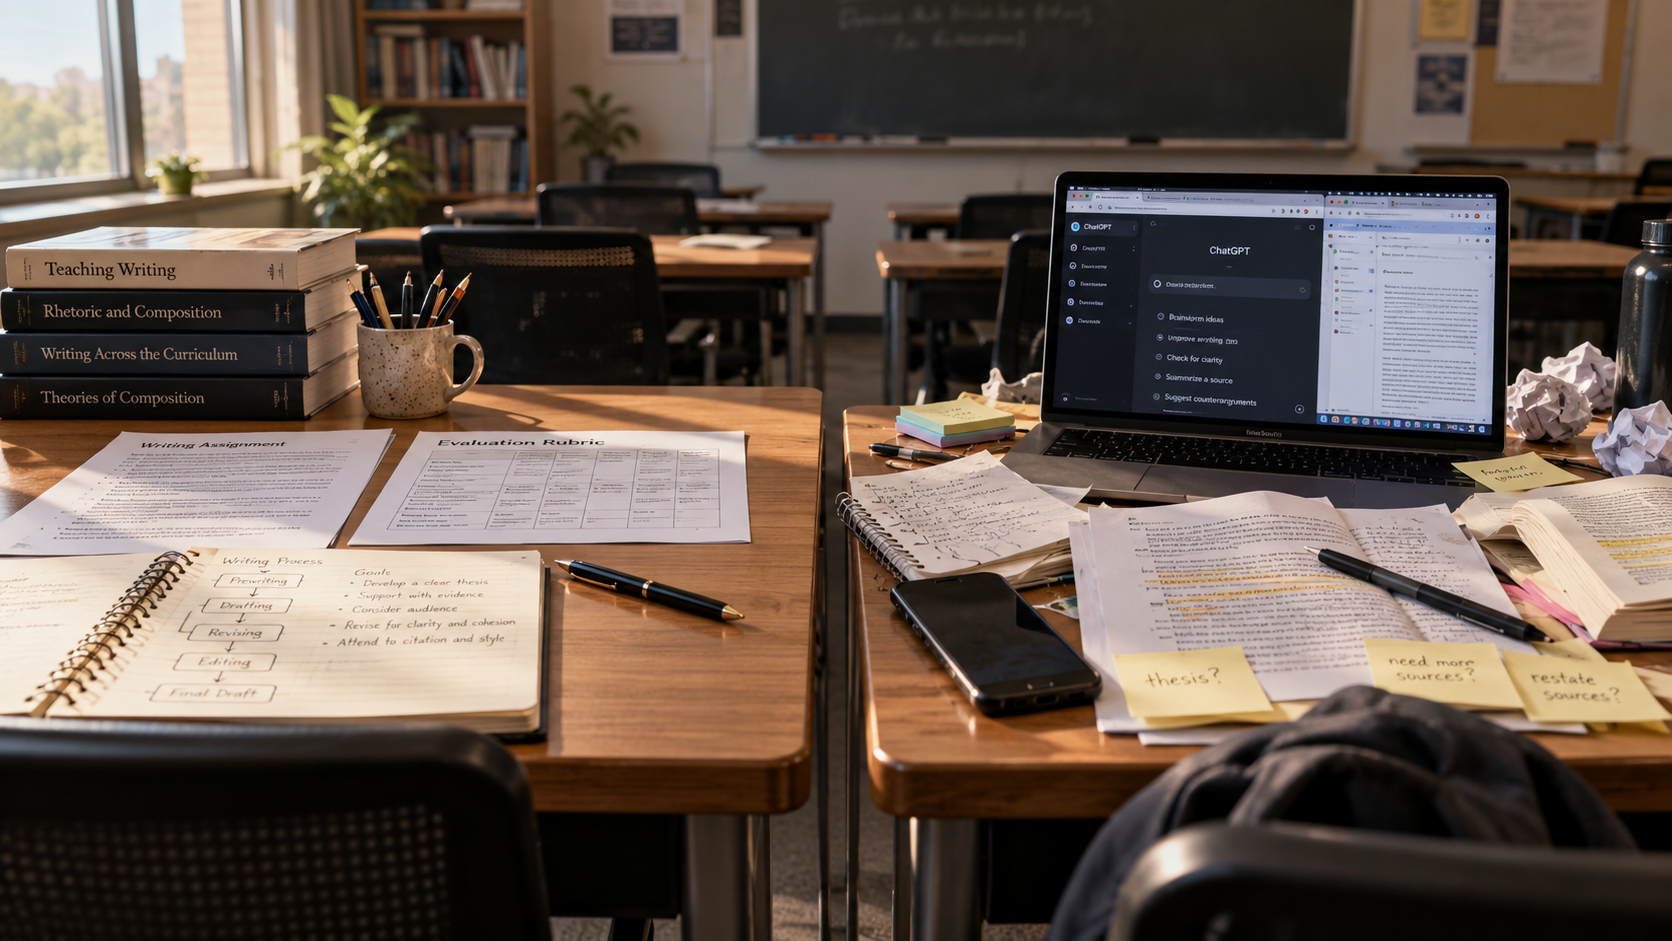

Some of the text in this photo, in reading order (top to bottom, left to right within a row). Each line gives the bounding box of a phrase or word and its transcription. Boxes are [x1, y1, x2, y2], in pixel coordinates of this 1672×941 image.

[1209, 245, 1251, 256] ChatGPT
[44, 261, 115, 281] Teaching
[117, 262, 177, 281] Writing
[43, 303, 103, 318] Rhetoric
[105, 304, 132, 318] and
[134, 304, 222, 323] Composition
[40, 347, 92, 364] Writing
[94, 347, 137, 361] Across
[139, 346, 161, 361] the
[163, 347, 239, 361] Curriculum
[1166, 353, 1189, 362] Check
[1189, 354, 1200, 363] for
[1209, 377, 1234, 385] source
[39, 390, 99, 404] Theories
[102, 389, 118, 404] of
[119, 390, 205, 408] Composition
[141, 441, 286, 450] Writing Assignment
[437, 438, 605, 447] Evaluation Rubric
[222, 556, 323, 569] Writing Process
[229, 576, 288, 587] Prewriting
[362, 579, 407, 589] Develop
[423, 578, 451, 586] clear
[457, 578, 489, 586] thesis
[357, 590, 484, 602] Support with evidence
[351, 604, 402, 614] Consider
[343, 617, 516, 631] Revise for clarity and cohesion
[207, 628, 263, 640] Revising
[385, 636, 397, 646] to
[402, 635, 447, 645] citation
[452, 633, 475, 643] and
[478, 633, 505, 647] style
[197, 656, 252, 670] Editing
[1388, 655, 1475, 667] need more
[1144, 666, 1222, 688] thesis?
[1396, 667, 1476, 683] sources?
[1530, 671, 1596, 686] restate
[169, 687, 257, 699] Final Draft
[1543, 686, 1621, 703] sources?
